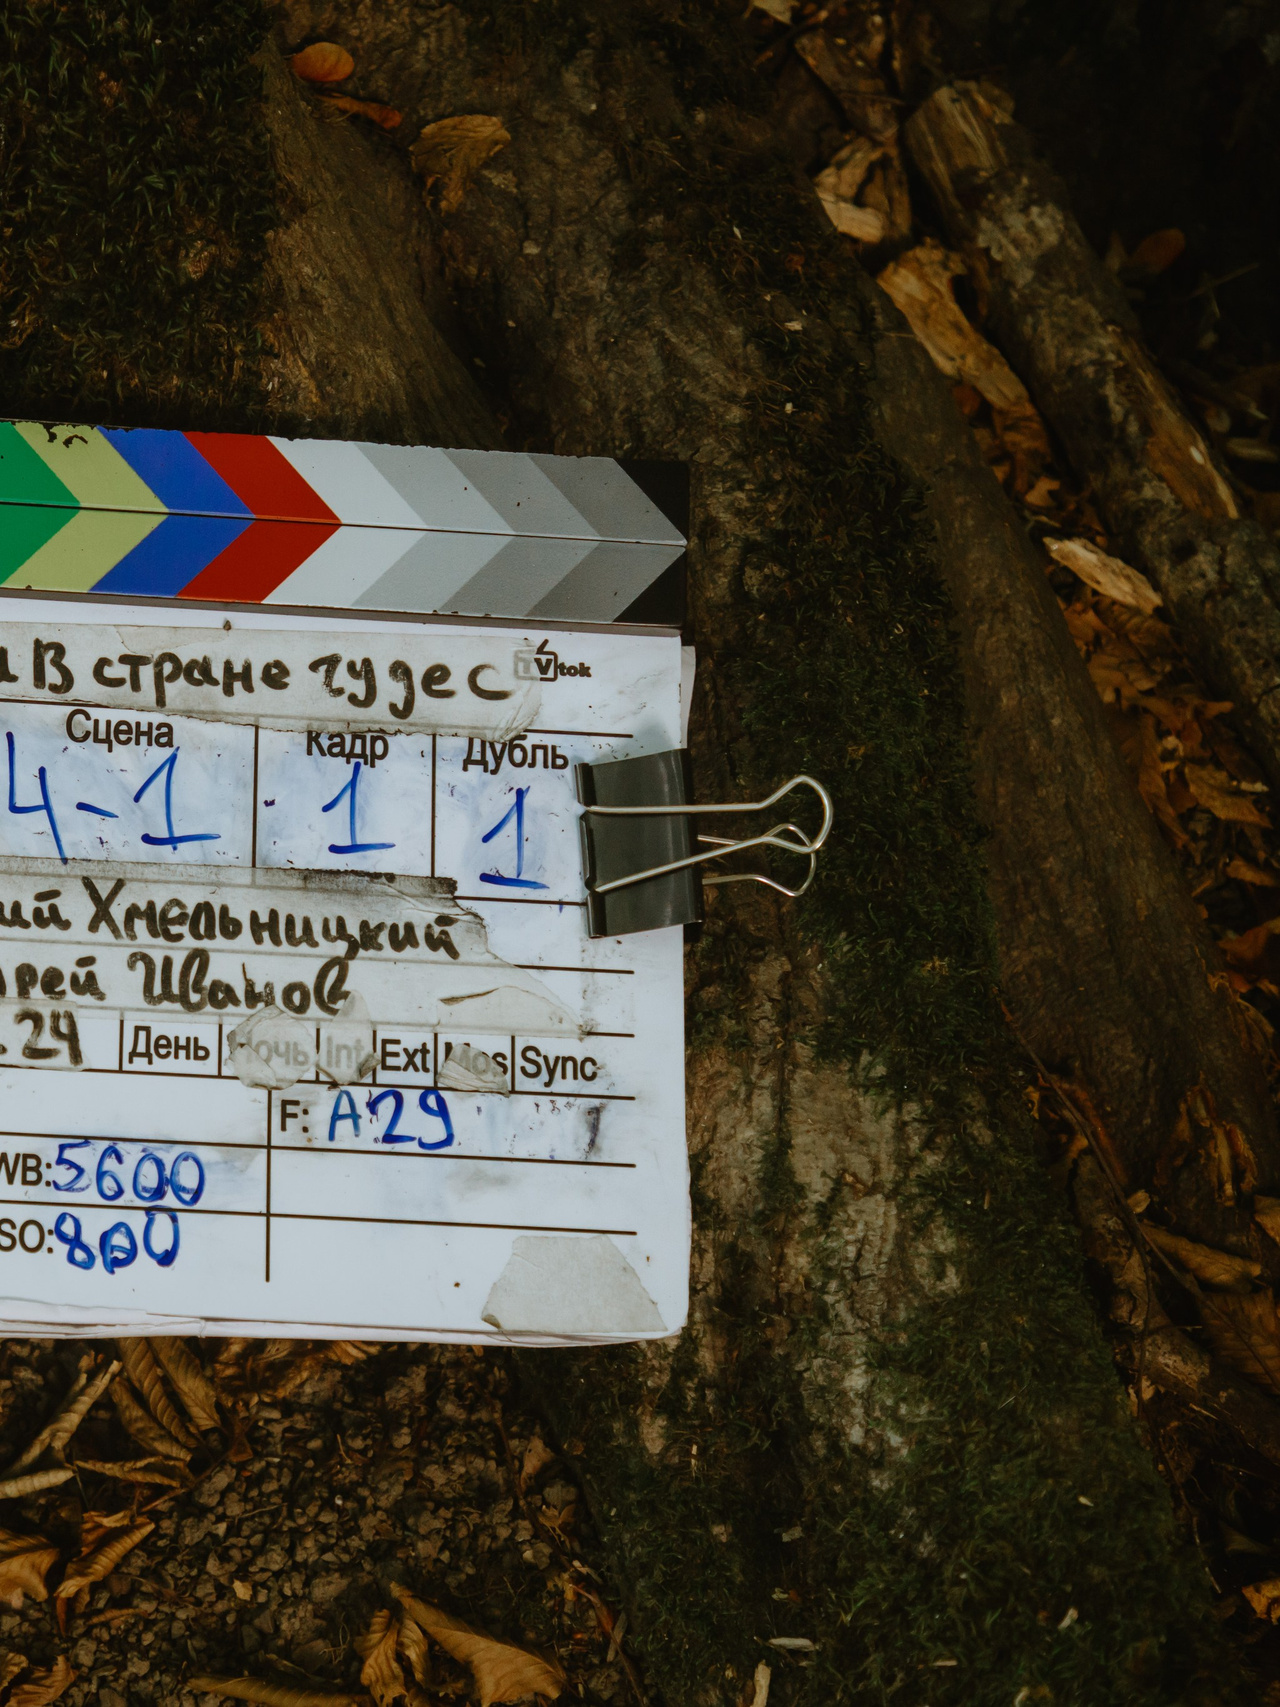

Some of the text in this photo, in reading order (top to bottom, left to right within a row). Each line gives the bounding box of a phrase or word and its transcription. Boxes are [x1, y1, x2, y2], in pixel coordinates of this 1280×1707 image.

[93, 652, 290, 707] стране
[65, 708, 174, 745] Сцена
[307, 730, 389, 768] Кадр
[462, 735, 570, 773] Дубль
[322, 761, 395, 854] 1
[480, 785, 550, 890] 1
[81, 876, 460, 962] Хмельницкий
[127, 948, 352, 1016] Иванов
[128, 1025, 210, 1062] День
[380, 1038, 431, 1073] Ext
[520, 1045, 598, 1088] Sync
[281, 1099, 309, 1133] F:
[52, 1139, 206, 1206] 5600
